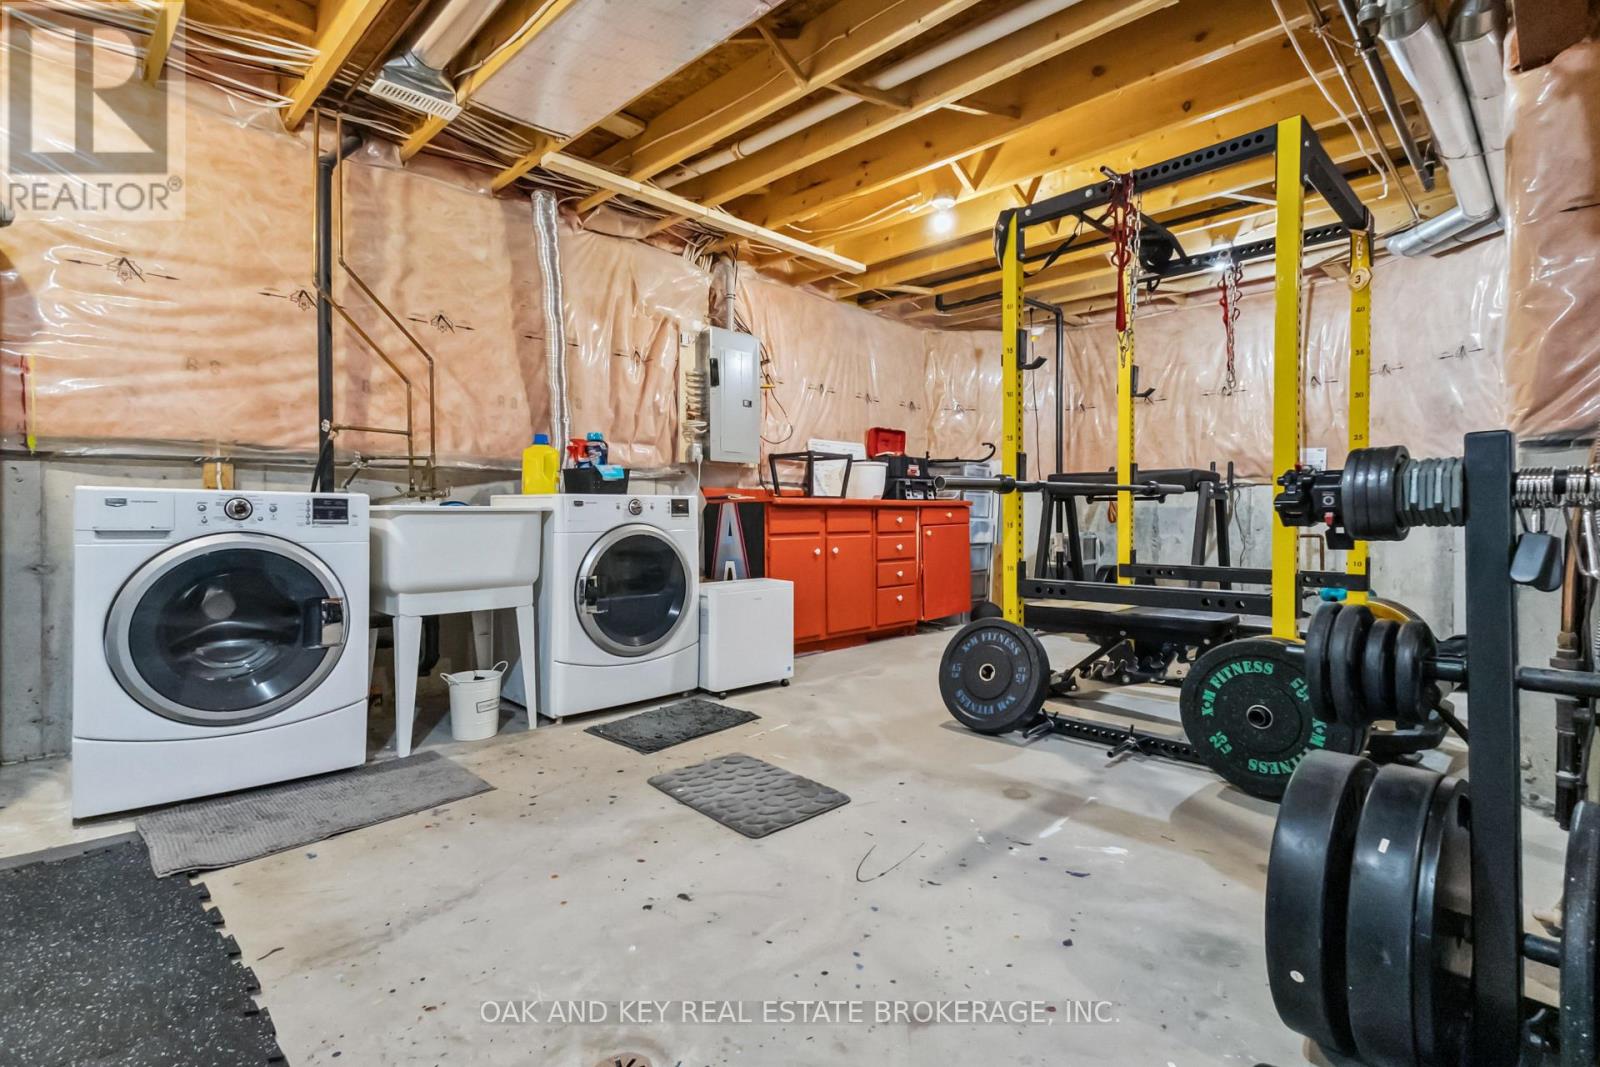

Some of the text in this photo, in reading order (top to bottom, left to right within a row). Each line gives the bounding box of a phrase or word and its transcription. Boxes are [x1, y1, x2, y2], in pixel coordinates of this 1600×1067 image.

[981, 632, 1021, 656] FITNESS
[1210, 660, 1274, 689] FITNESS
[955, 689, 995, 715] FITNESS
[1208, 731, 1228, 749] 25
